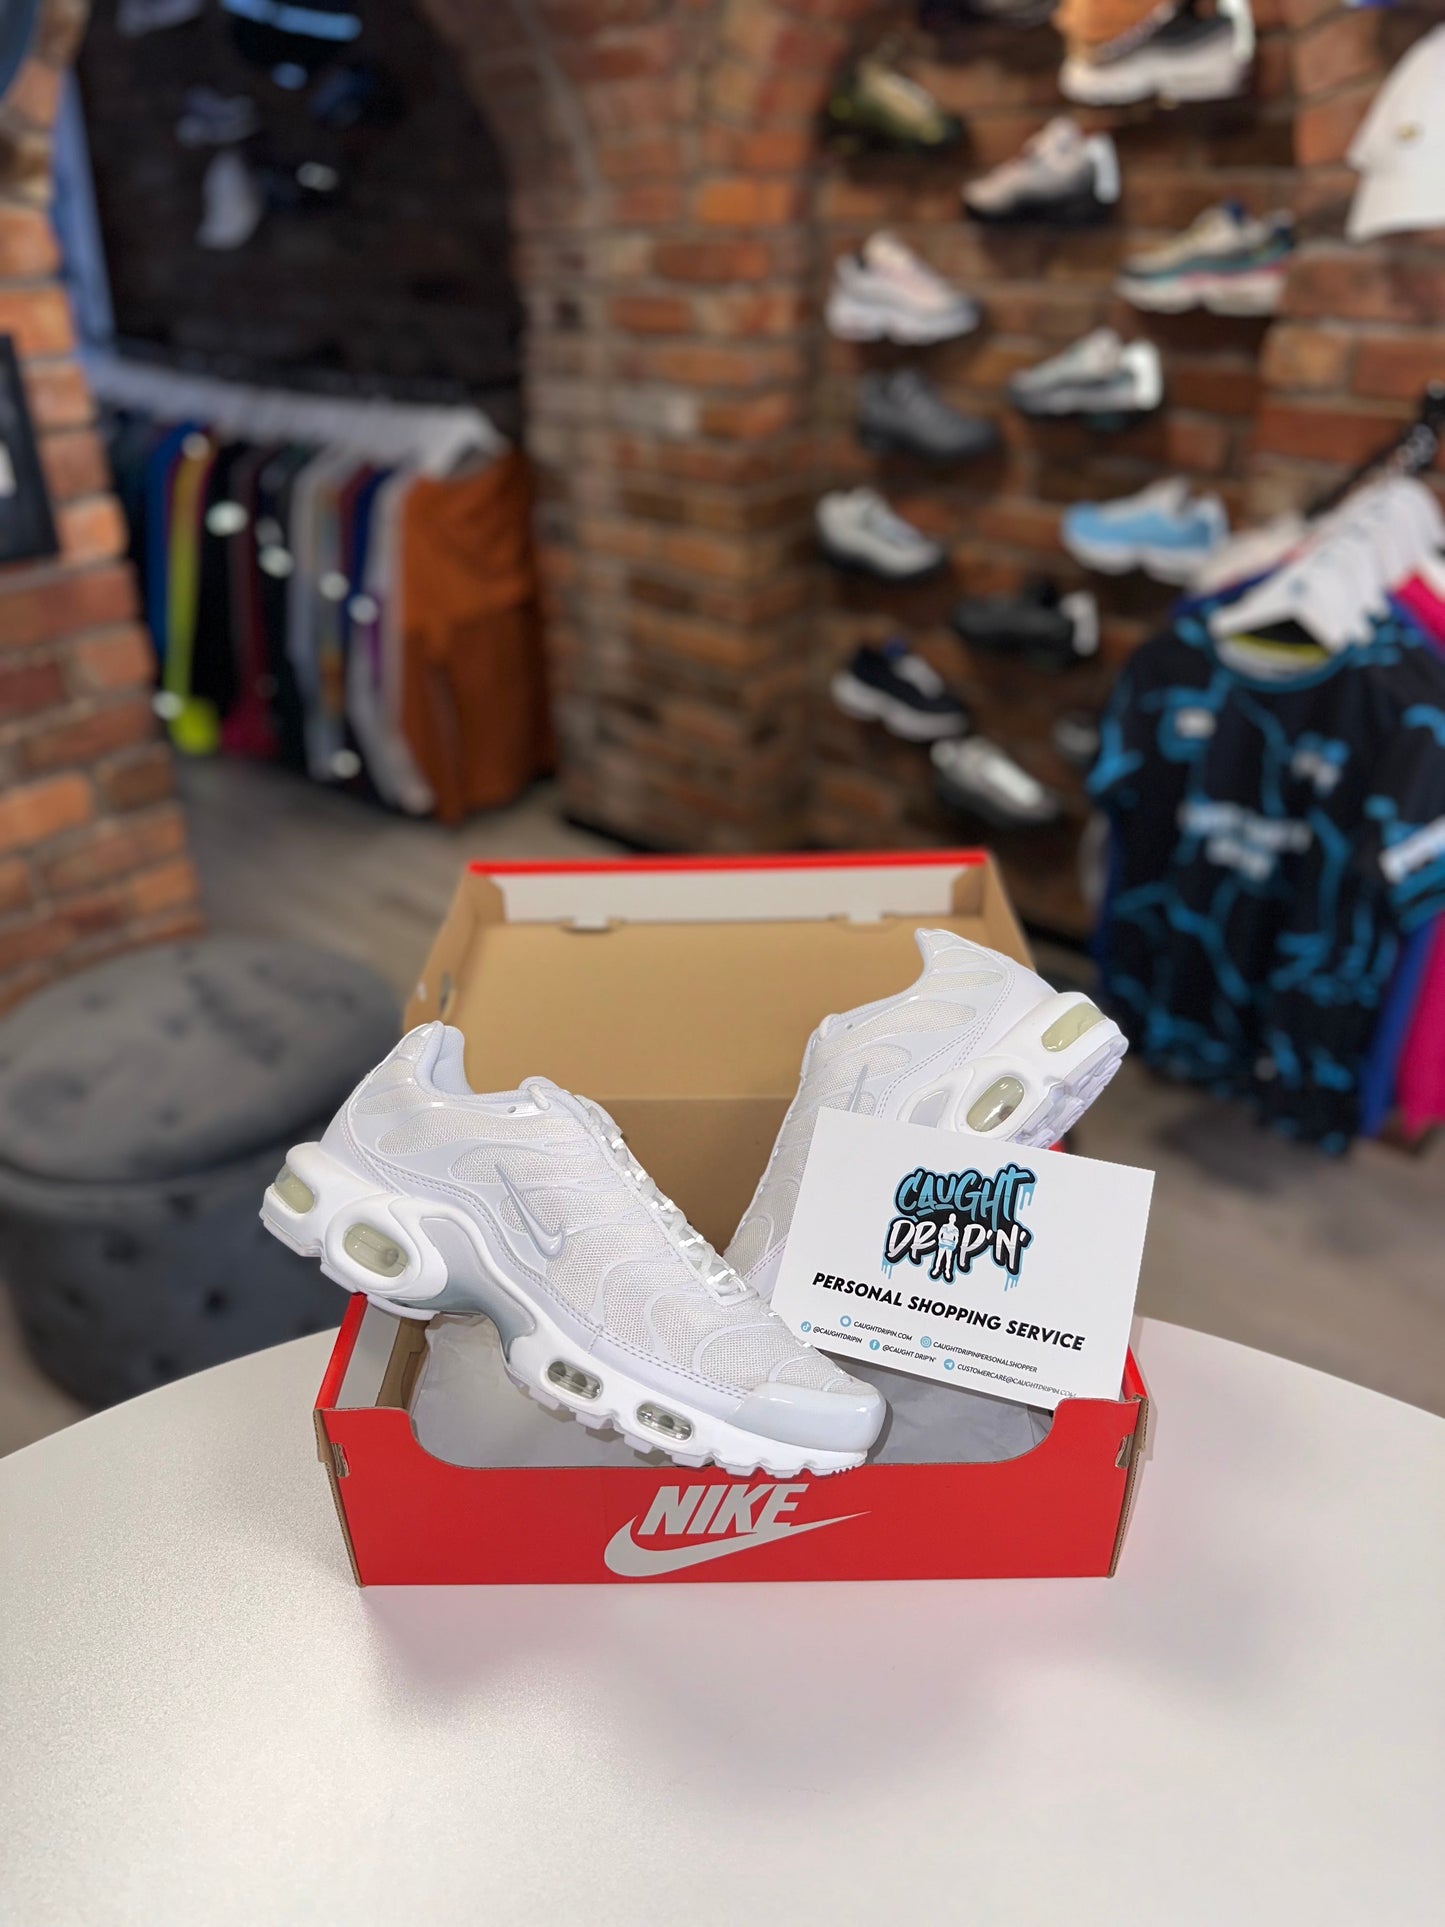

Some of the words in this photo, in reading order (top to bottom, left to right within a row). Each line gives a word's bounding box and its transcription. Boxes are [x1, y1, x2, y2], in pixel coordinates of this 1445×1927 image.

[898, 1167, 1030, 1232] CAUGHT
[812, 1272, 902, 1306] PERSONAL
[908, 1296, 1001, 1331] SHOPPING
[1005, 1320, 1085, 1351] SERVICE
[812, 1326, 863, 1344] @CAUGHTDRIPIN
[853, 1321, 912, 1341] CAUGHTDRIPIN.COM
[882, 1344, 914, 1358] @CAUGHT
[933, 1341, 1038, 1373] CAUGHTDRIPINPERSONALSHOPPER
[637, 1483, 810, 1536] NIKE
